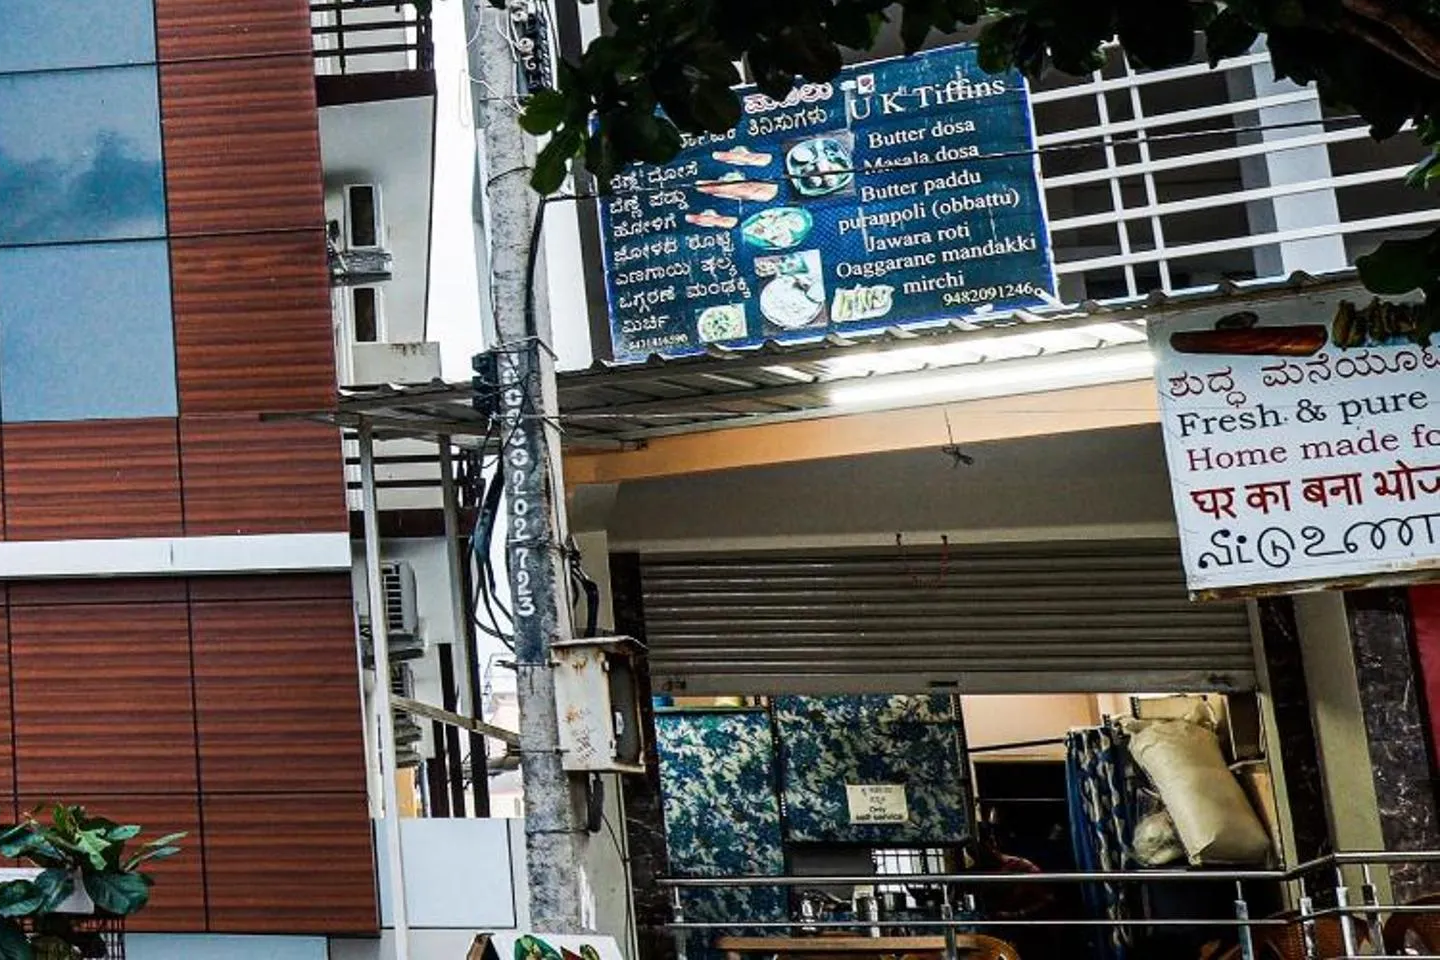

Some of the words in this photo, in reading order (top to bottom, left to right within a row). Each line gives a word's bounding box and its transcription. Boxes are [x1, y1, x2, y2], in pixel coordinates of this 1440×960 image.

[849, 95, 872, 121] U
[880, 89, 907, 115] K
[913, 77, 1006, 109] Tiffins
[867, 128, 926, 149] Butter
[930, 119, 976, 138] dosa
[935, 144, 979, 162] dosa
[860, 182, 920, 203] Butter
[923, 170, 981, 193] paddu
[838, 202, 927, 234] puranpoli
[931, 187, 1020, 218] (obbattu)
[866, 233, 933, 253] Jawara
[937, 222, 970, 241] roti
[835, 253, 937, 280] Oaggarane
[941, 233, 1037, 263] mandakki
[902, 270, 965, 295] mirchi
[1295, 398, 1328, 424] &
[1337, 390, 1428, 425] pure
[1187, 444, 1288, 472] Home
[1300, 428, 1399, 461] made
[1190, 487, 1237, 520] घर
[1244, 480, 1291, 515] का
[1302, 472, 1363, 508] बना
